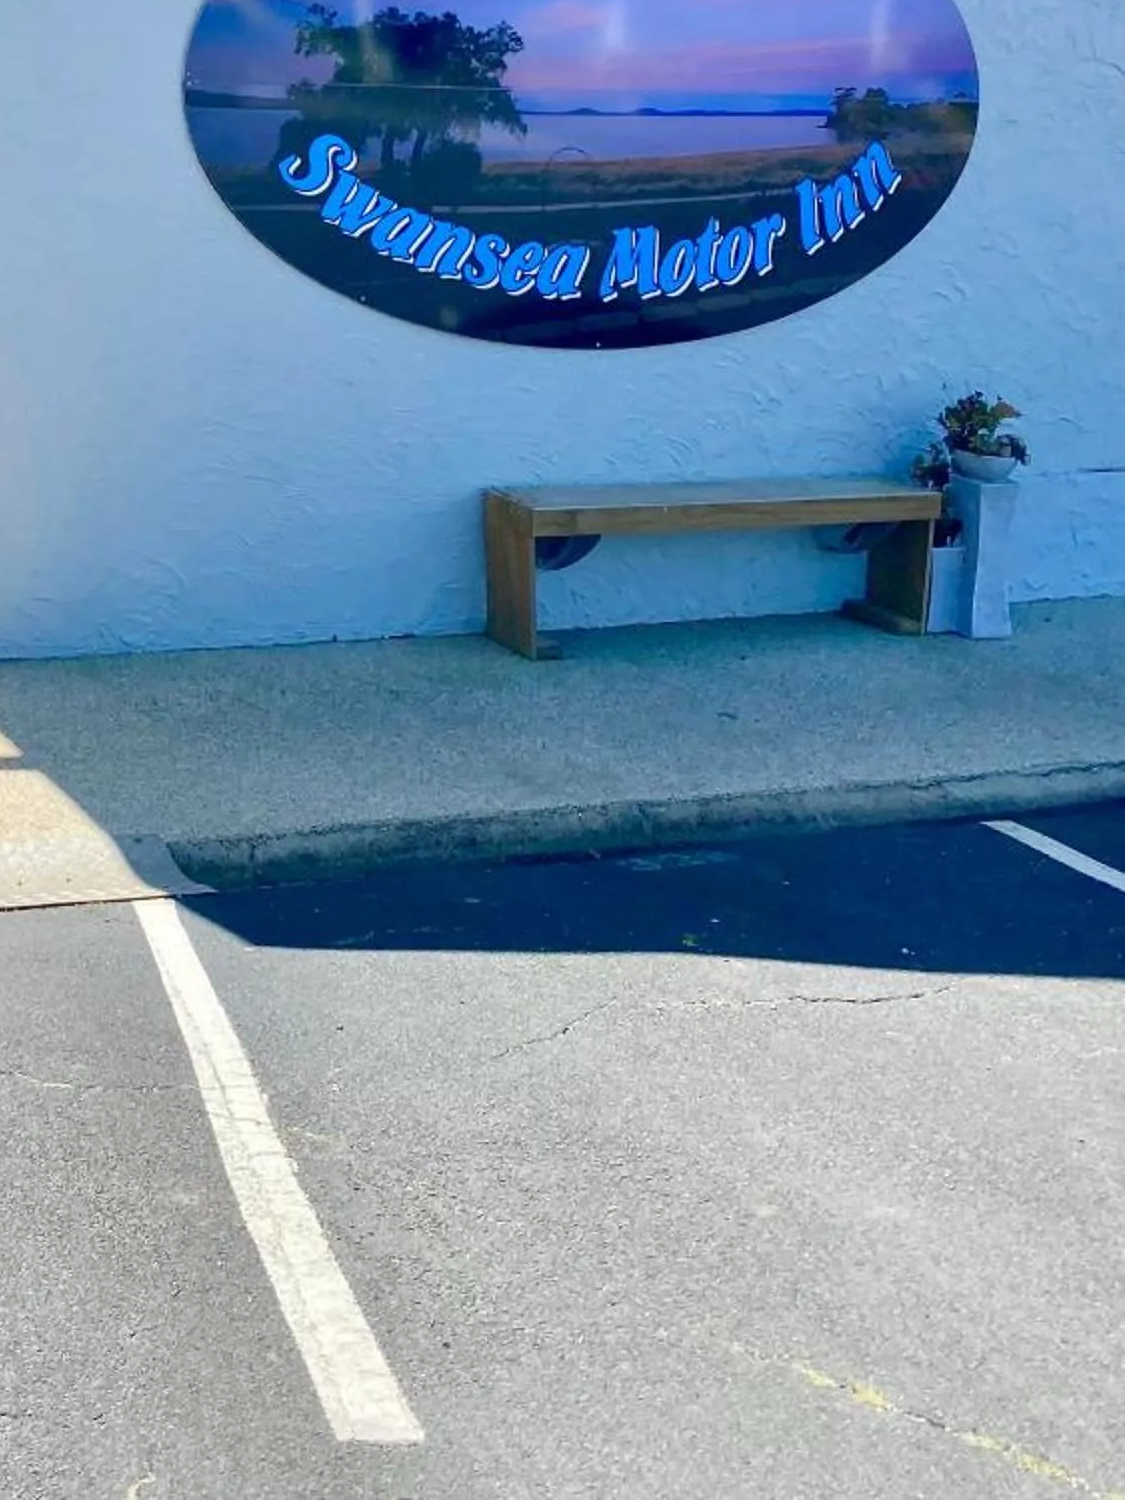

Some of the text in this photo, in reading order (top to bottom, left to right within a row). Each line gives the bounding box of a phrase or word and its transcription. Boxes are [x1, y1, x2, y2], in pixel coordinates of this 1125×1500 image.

[278, 133, 903, 302] Swansea Motor Inn
